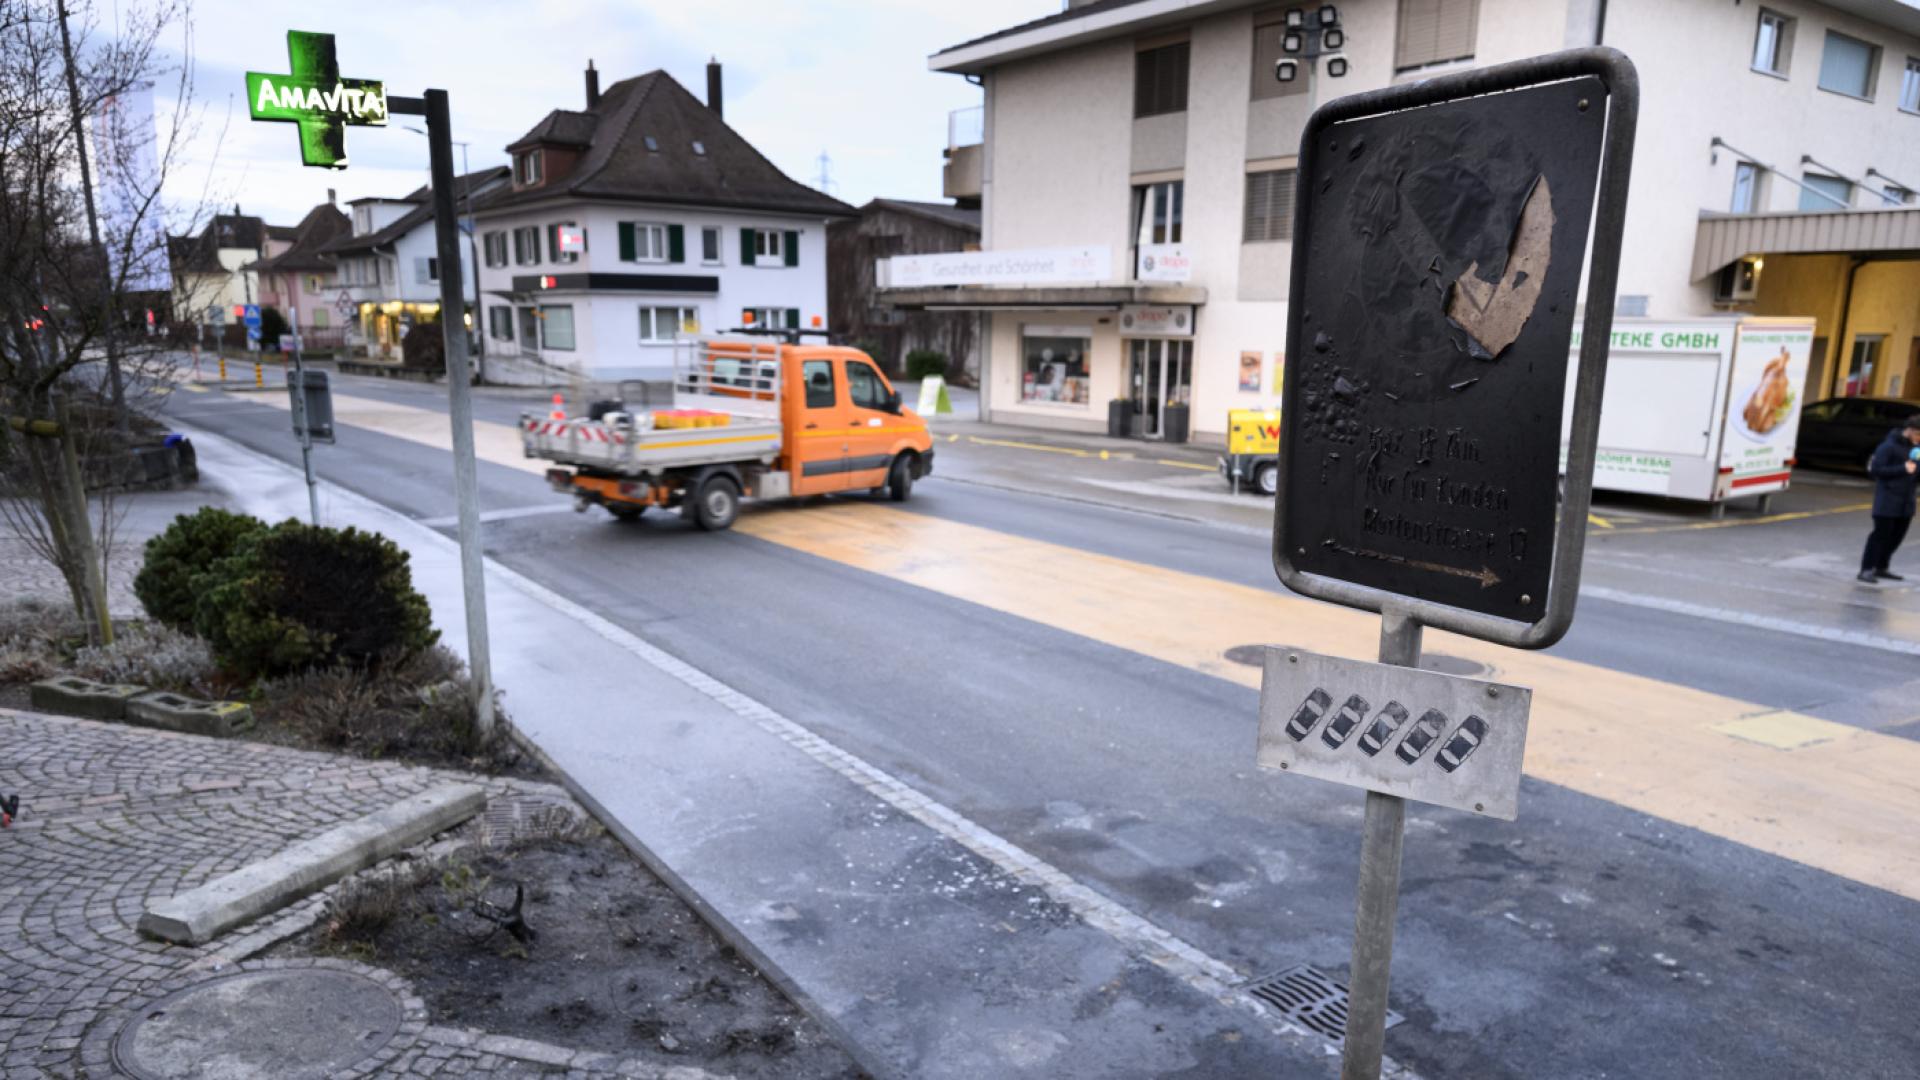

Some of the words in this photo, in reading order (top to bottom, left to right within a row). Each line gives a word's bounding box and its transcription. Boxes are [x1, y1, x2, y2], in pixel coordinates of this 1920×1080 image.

[985, 260, 1001, 275] und
[1661, 332, 1720, 348] GMBH
[1437, 477, 1509, 511] Kunden
